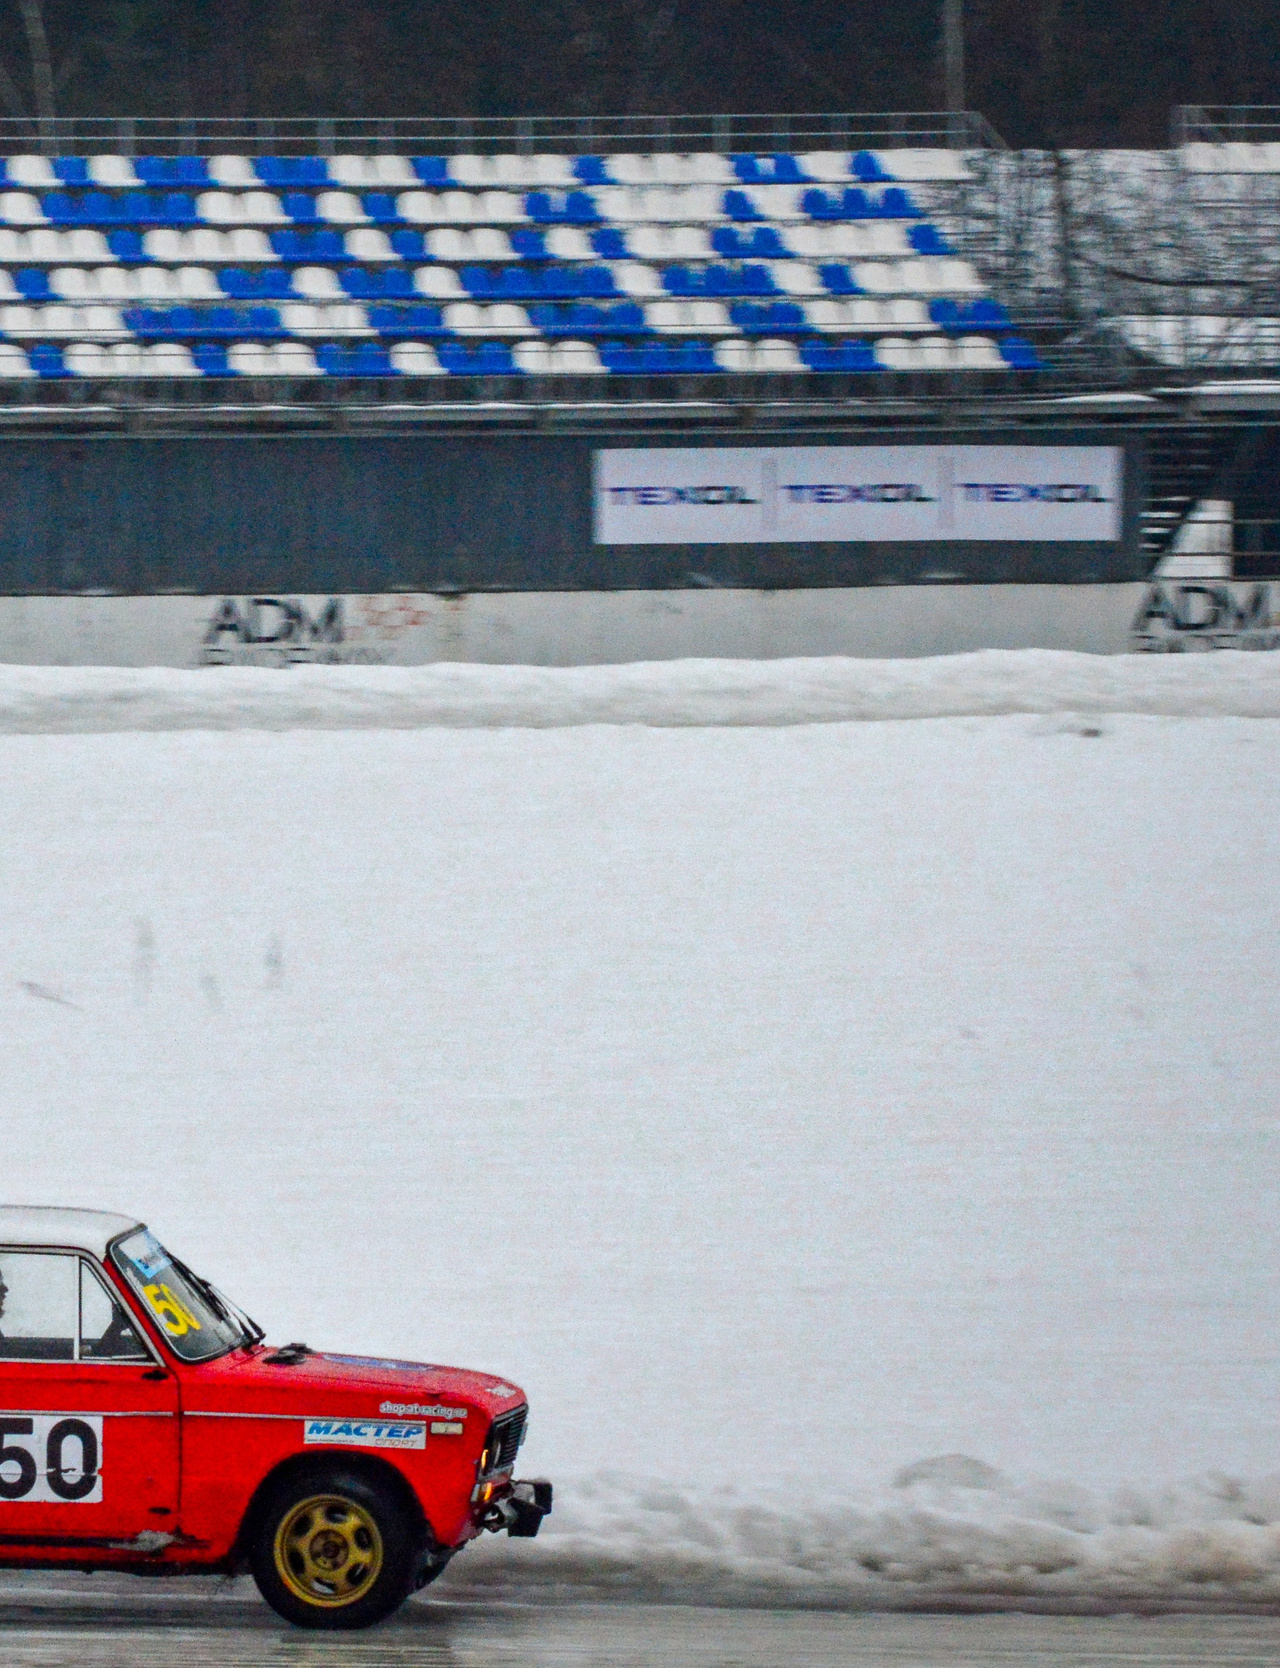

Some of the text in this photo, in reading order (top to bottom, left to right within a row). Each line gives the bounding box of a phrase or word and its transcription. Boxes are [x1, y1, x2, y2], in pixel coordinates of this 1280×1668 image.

[202, 597, 344, 644] ADM
[1130, 584, 1272, 631] ADM
[143, 1283, 202, 1335] 50
[307, 1422, 424, 1438] МАСТЕР
